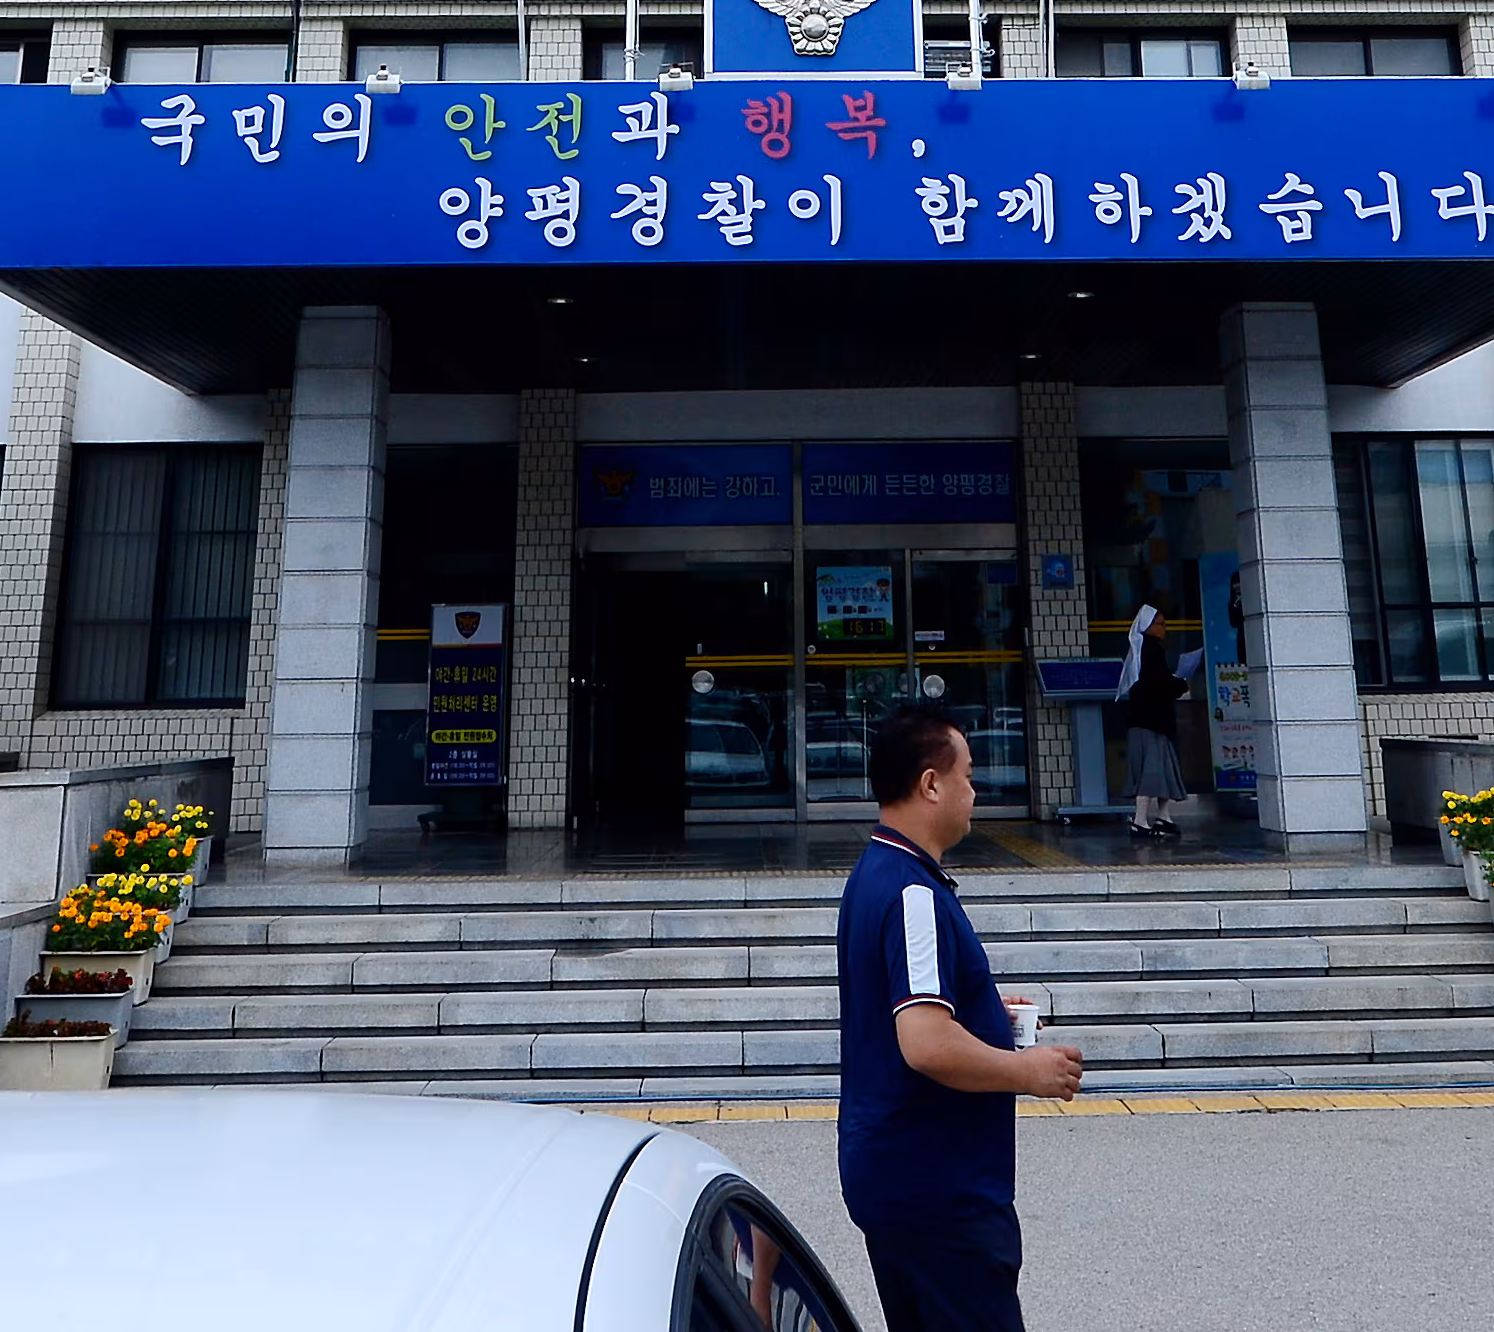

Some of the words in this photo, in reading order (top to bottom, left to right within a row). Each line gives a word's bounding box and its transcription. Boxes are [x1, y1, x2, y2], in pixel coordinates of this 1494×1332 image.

[140, 92, 373, 166] 국민의
[445, 91, 681, 161] 안전과
[741, 90, 927, 161] 행복,
[438, 172, 843, 250] 양평경찰이
[649, 475, 718, 499] 범죄에는
[810, 474, 878, 497] 군민에게
[885, 474, 937, 496] 든든한
[942, 473, 1012, 497] 양평경찰
